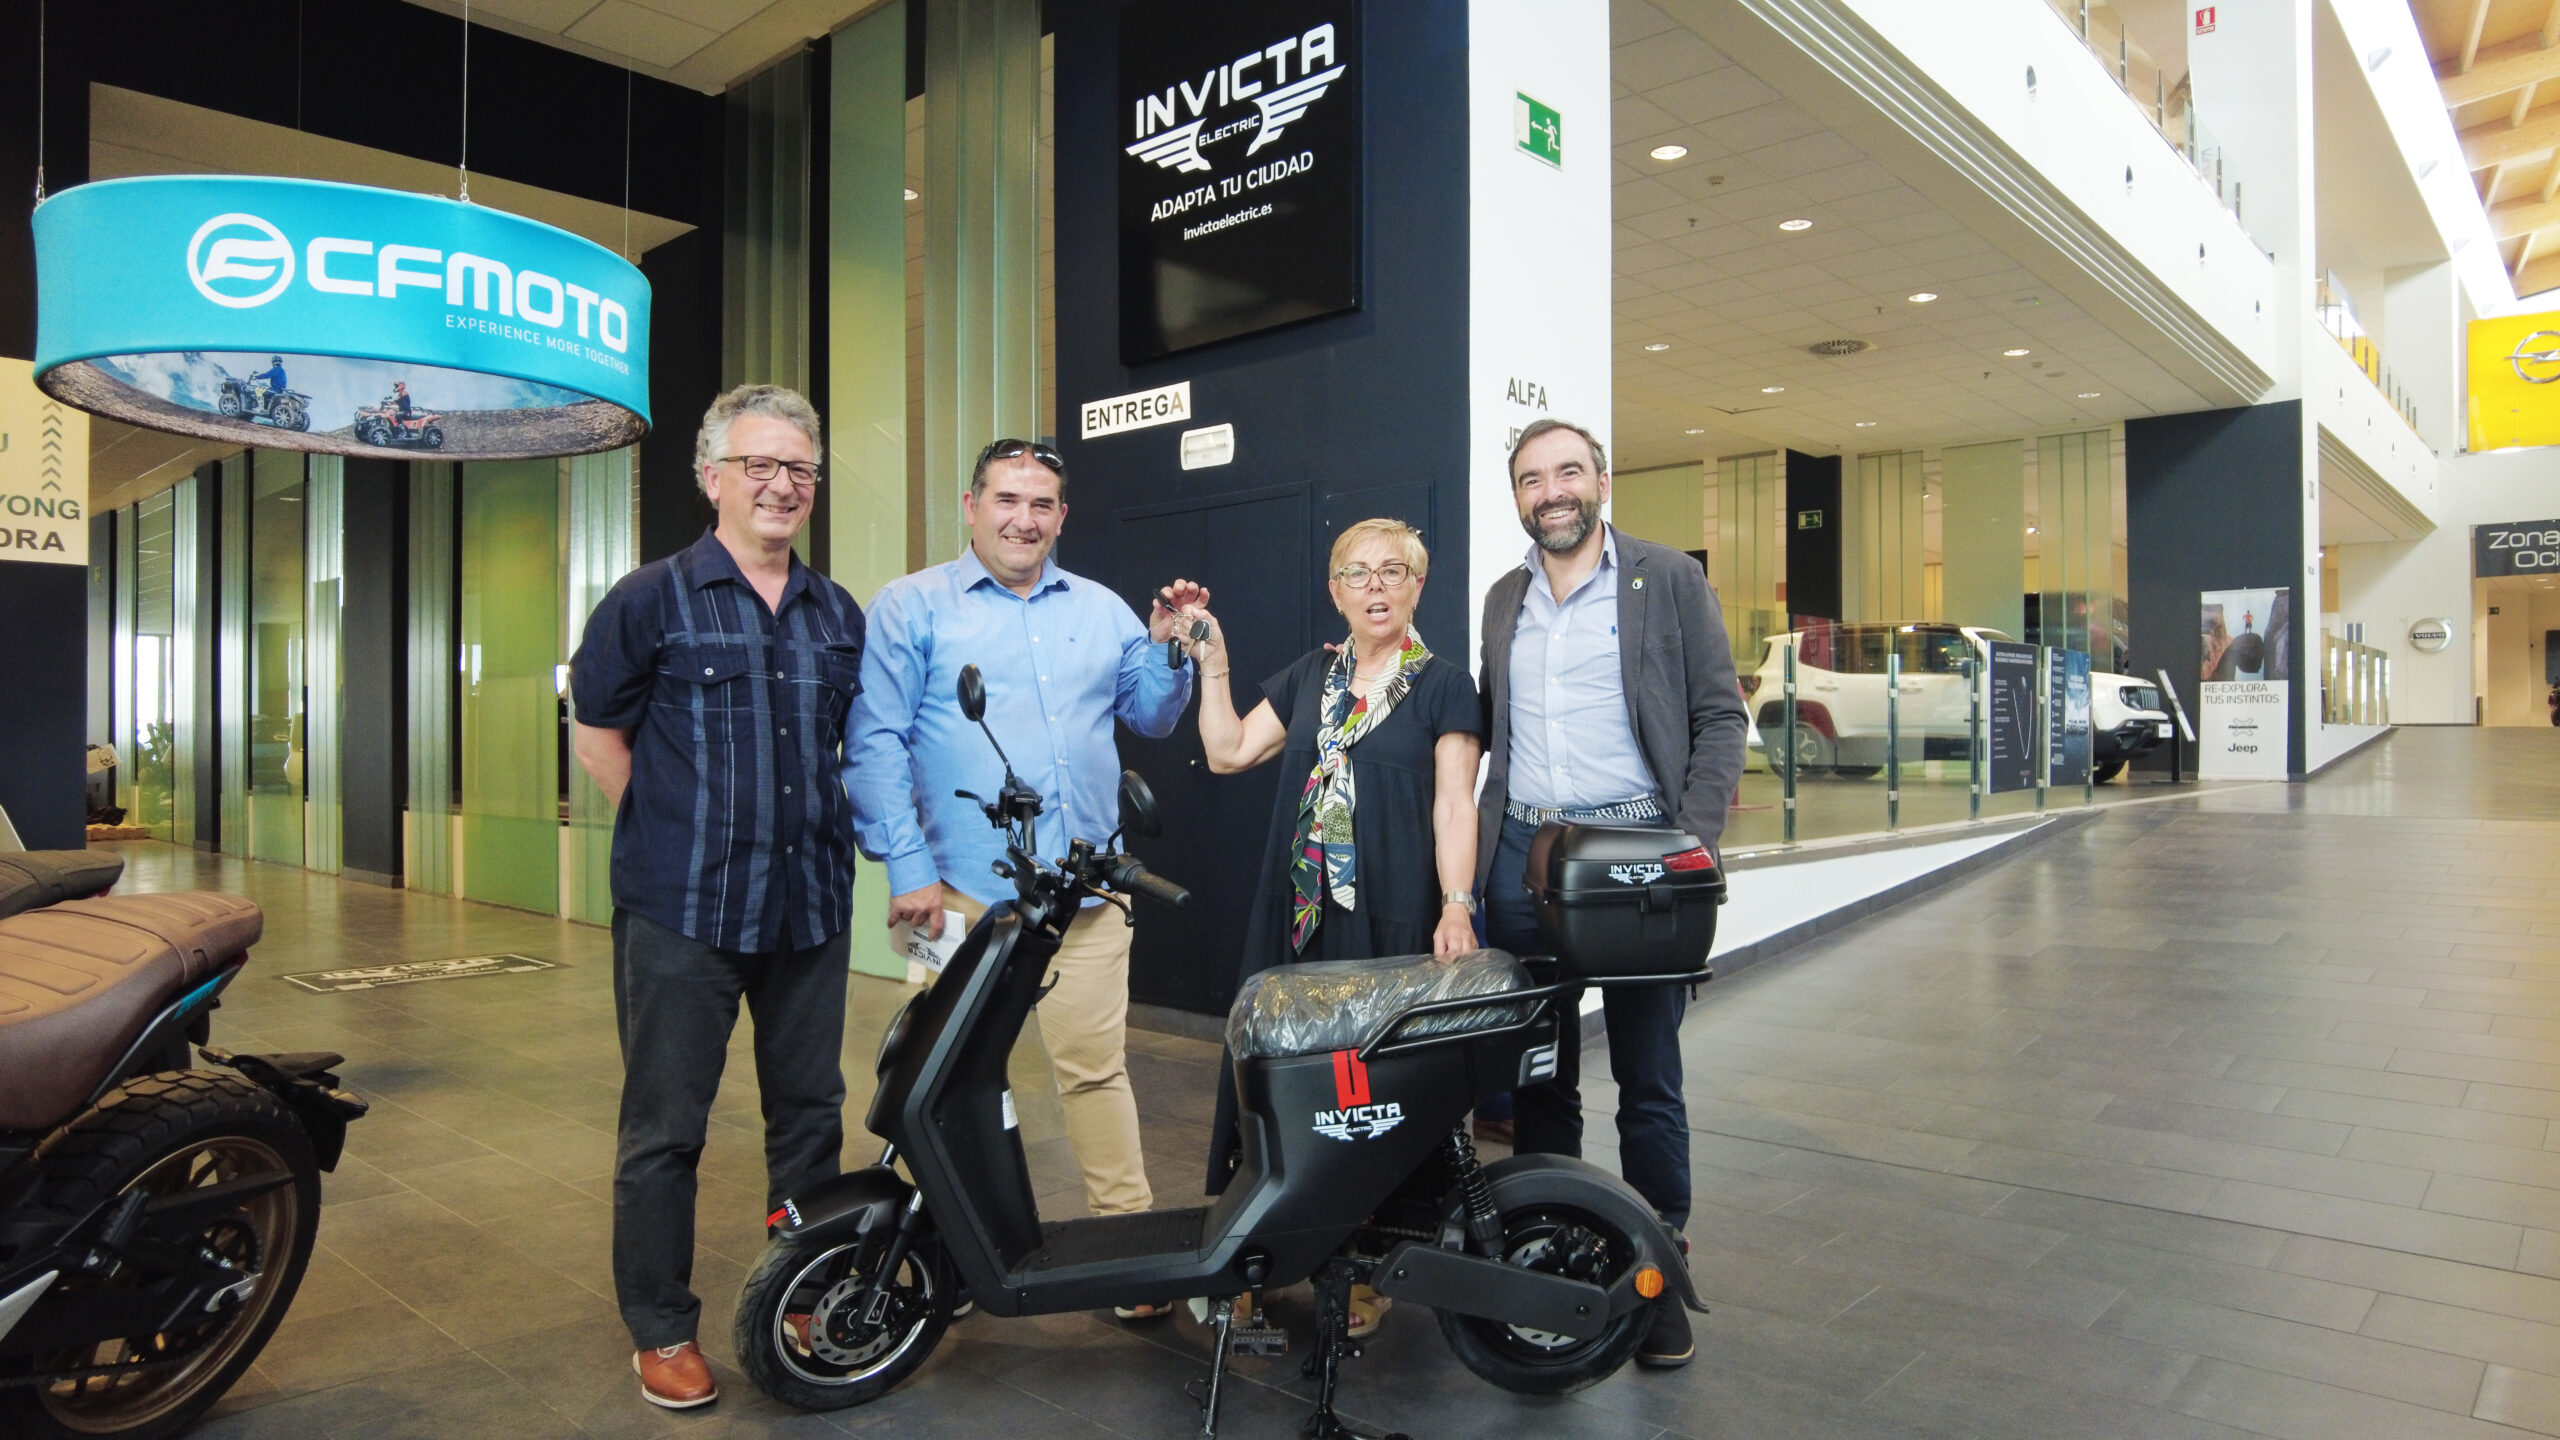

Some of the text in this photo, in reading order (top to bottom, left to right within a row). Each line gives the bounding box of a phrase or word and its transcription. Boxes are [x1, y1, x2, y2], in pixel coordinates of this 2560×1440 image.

[1136, 23, 1334, 139] INVICTA
[1199, 115, 1260, 147] ELECTRIC
[1151, 151, 1314, 222] ADAPTA TU CIUDAD
[1184, 203, 1272, 240] invictaelectric.es
[307, 237, 628, 354] CFMOTO
[446, 315, 629, 376] EXPERIENCE MORE TOGETHER
[1507, 377, 1547, 411] ALFA
[1086, 391, 1184, 431] ENTREGA
[2489, 530, 2560, 549] Zona
[2205, 683, 2268, 693] RE-EXPLORA
[2205, 694, 2280, 704] TUS INSTINTOS
[2228, 743, 2258, 754] Jeep
[1610, 863, 1662, 874] INVICTA
[908, 945, 941, 966] INVICTA
[1315, 1102, 1401, 1126] INVICTA
